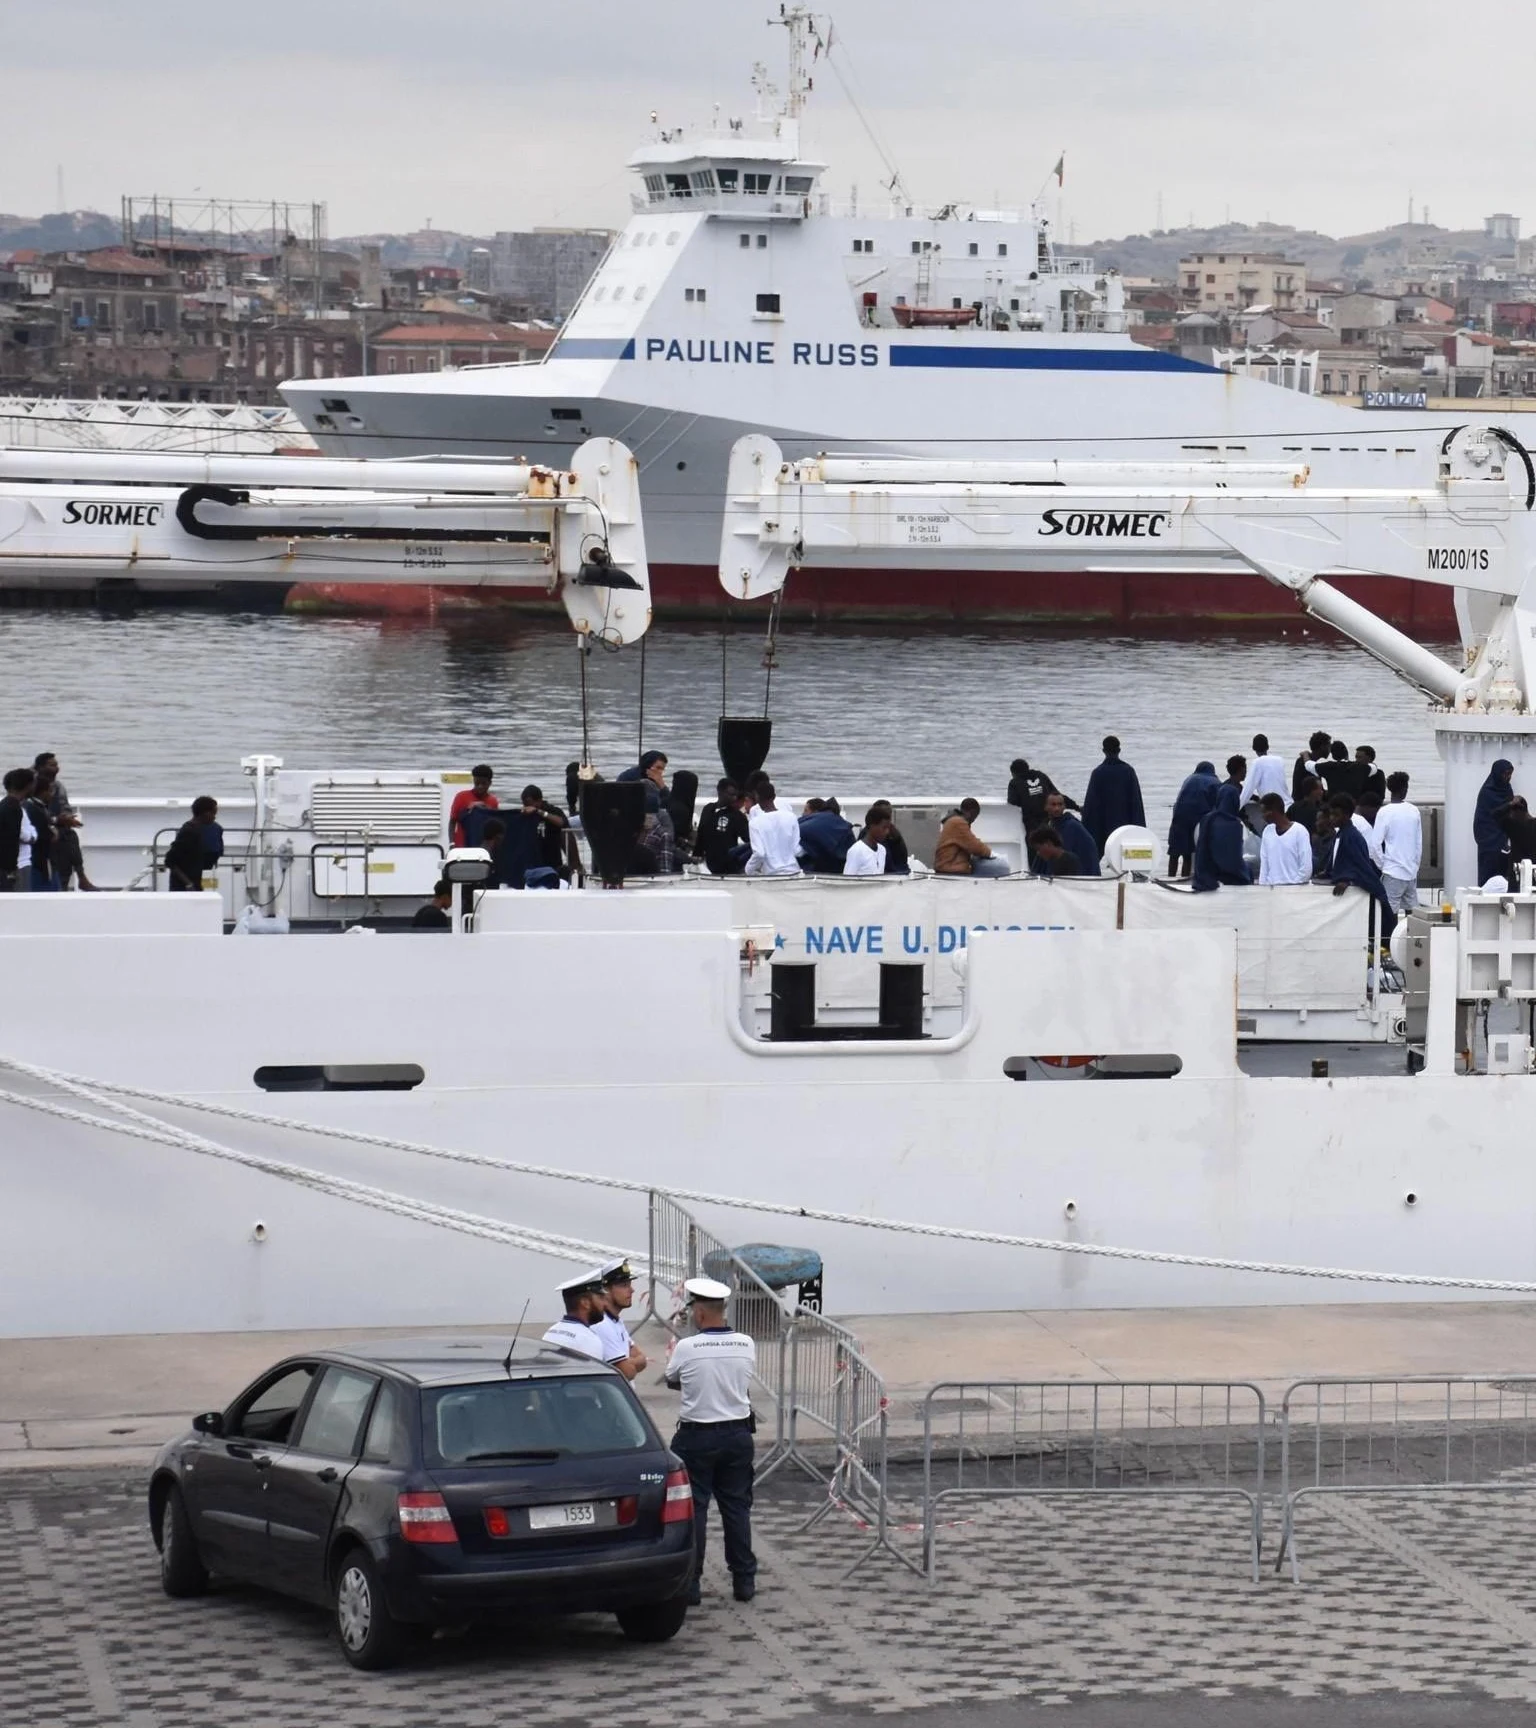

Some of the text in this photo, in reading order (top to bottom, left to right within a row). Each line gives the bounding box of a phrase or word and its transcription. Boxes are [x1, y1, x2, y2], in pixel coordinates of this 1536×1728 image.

[646, 338, 878, 366] PAULINE RUSS
[1366, 391, 1425, 406] POLIZIA
[62, 500, 163, 526] SORMEC
[1038, 509, 1171, 536] SORMEC
[1428, 548, 1489, 570] M200/1S
[806, 926, 883, 954] NAVE
[564, 1505, 592, 1521] 1533
